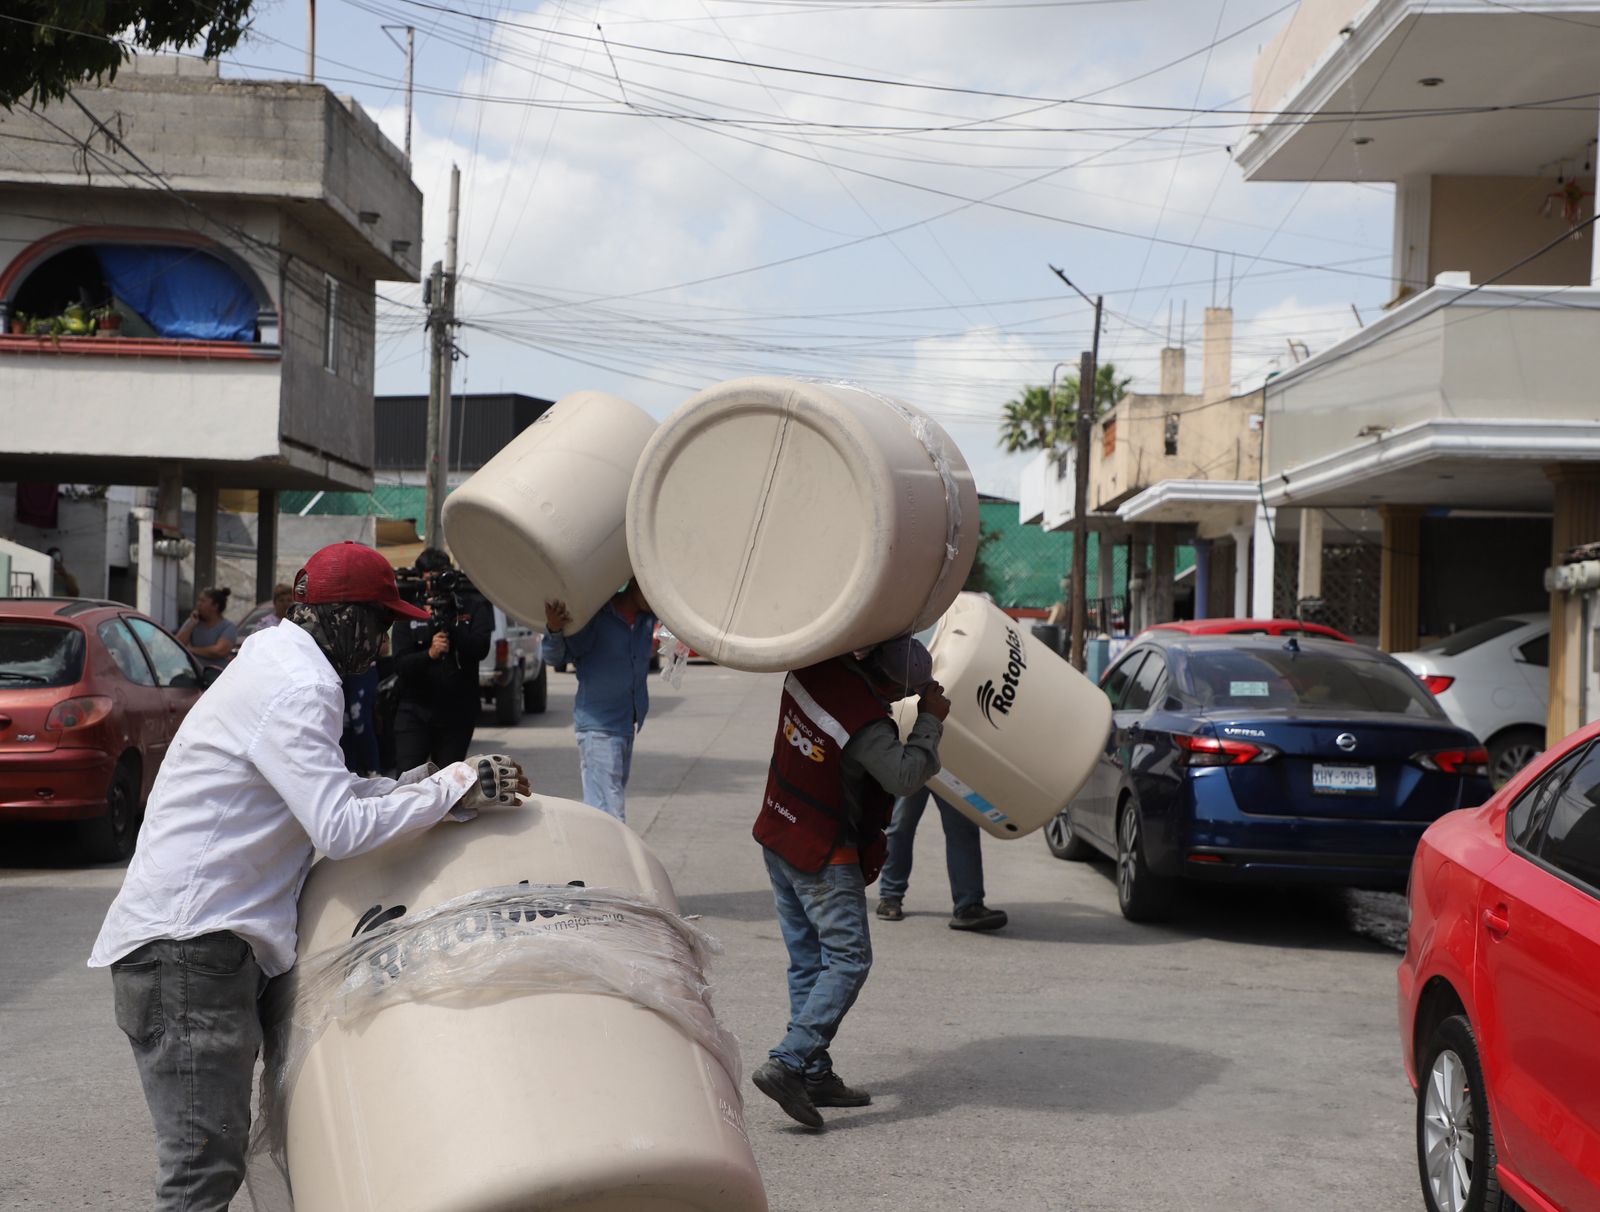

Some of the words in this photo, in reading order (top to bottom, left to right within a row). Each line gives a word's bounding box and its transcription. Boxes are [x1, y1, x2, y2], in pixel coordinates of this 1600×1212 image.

[991, 626, 1028, 716] Rotoplas
[1224, 727, 1266, 737] VERSA
[554, 914, 592, 932] mejor
